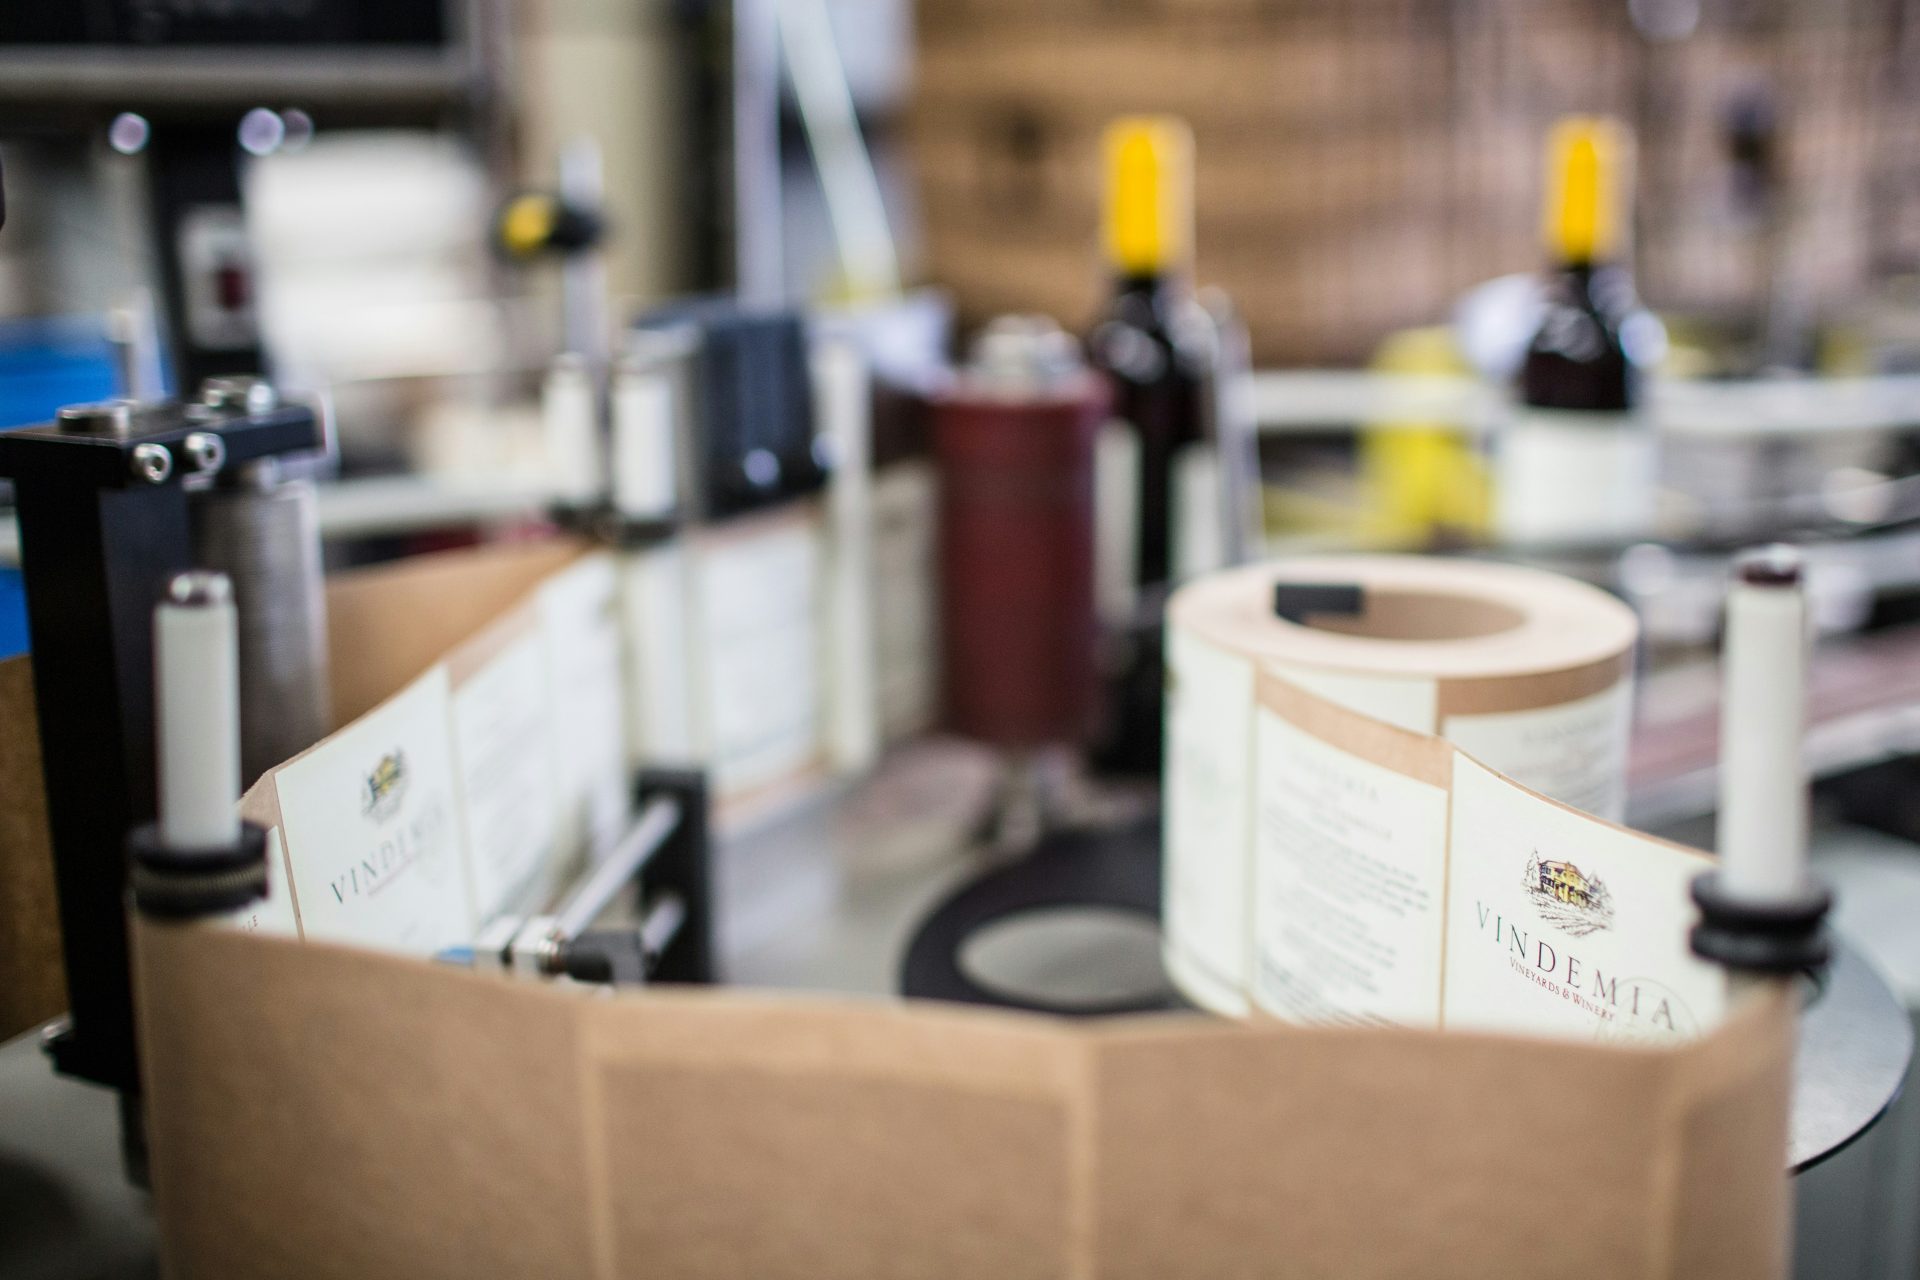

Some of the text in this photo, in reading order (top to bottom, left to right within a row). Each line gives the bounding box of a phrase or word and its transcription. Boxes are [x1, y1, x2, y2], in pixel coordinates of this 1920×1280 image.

[1476, 900, 1676, 1031] VINDEMIA
[1509, 956, 1616, 1022] VINEYARDS & WINERY
